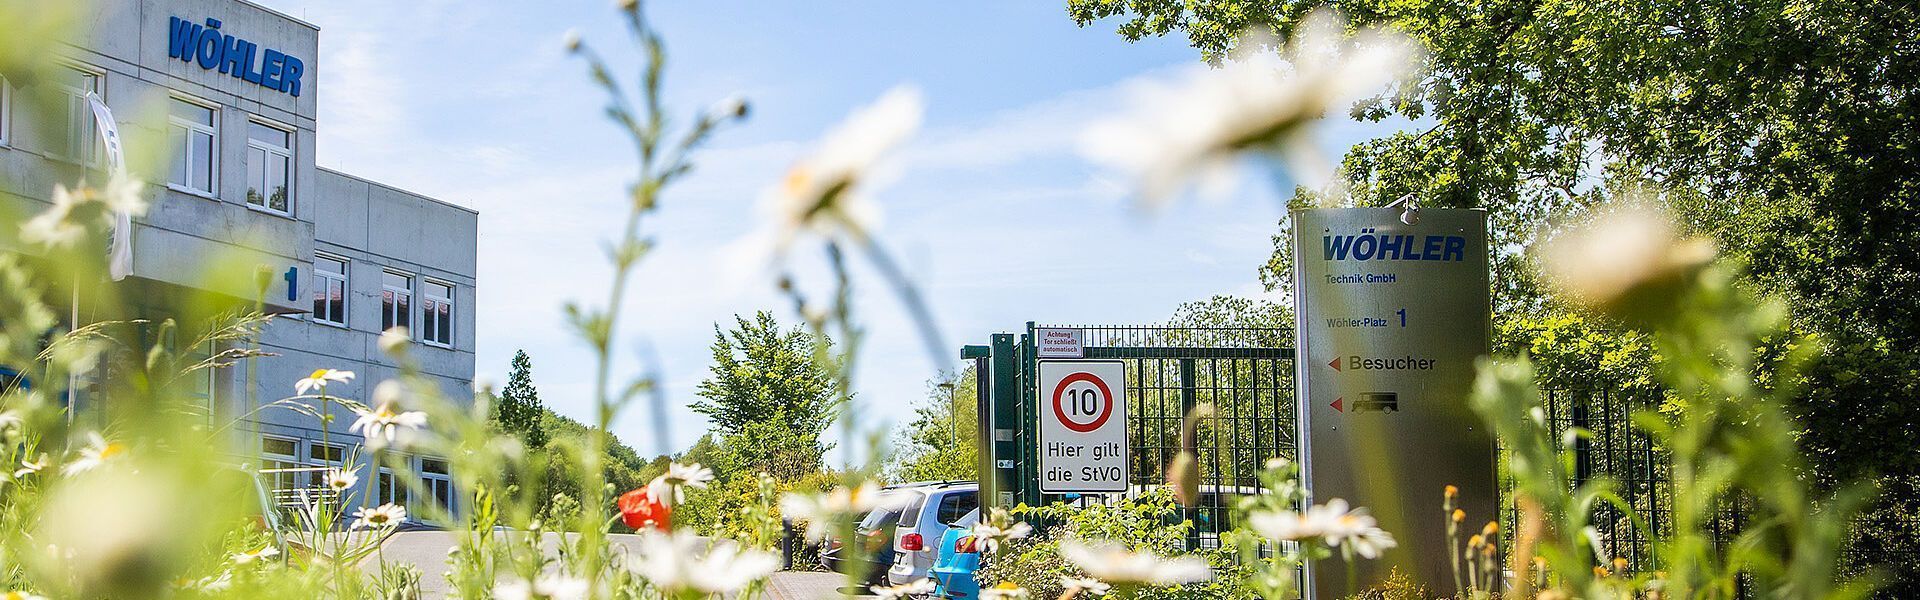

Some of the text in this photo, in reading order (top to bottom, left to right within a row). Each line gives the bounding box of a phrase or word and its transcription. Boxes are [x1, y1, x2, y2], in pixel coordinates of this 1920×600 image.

[168, 16, 304, 97] WÖHLER
[1323, 228, 1466, 262] WÖHLER
[284, 266, 297, 301] 1
[1325, 273, 1396, 284] Technik GmbH
[1326, 308, 1407, 328] Wöhler-Platz 1
[1047, 331, 1073, 339] Achtung!
[1350, 355, 1436, 371] Besucher
[1068, 388, 1098, 416] 10
[1048, 442, 1120, 461] Hier gilt
[1047, 466, 1121, 482] die StVO
